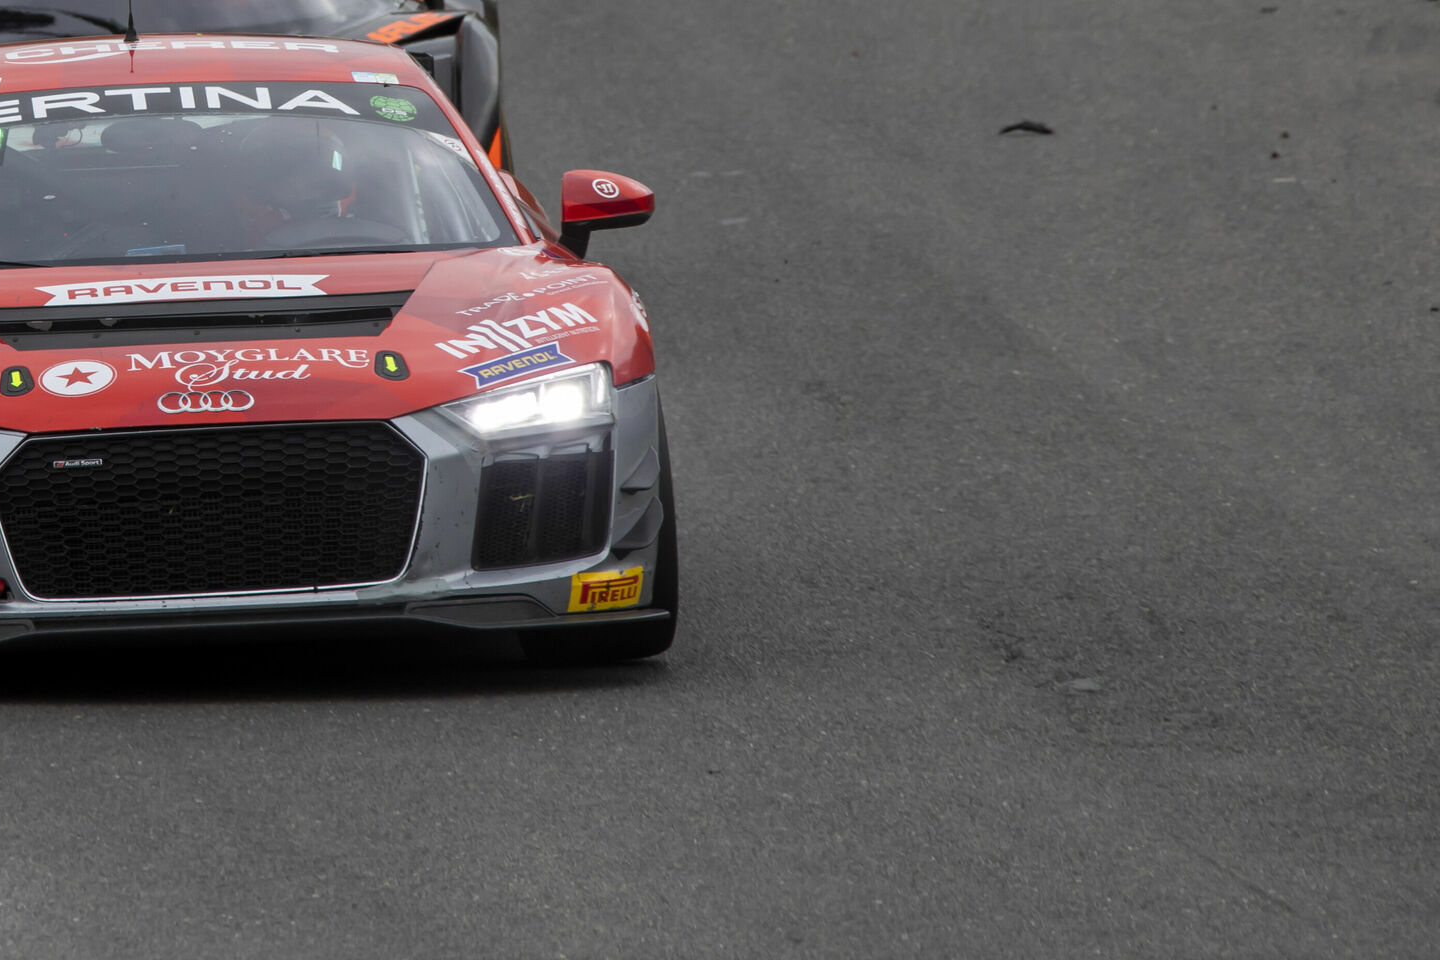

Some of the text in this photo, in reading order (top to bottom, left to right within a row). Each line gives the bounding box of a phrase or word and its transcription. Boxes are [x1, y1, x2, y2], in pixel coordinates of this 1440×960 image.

[67, 279, 302, 300] RAVENOL
[125, 348, 370, 372] MOYGLARE
[478, 352, 558, 379] RAVENOL
[174, 359, 311, 393] Stud
[579, 575, 640, 605] PIRELLI
